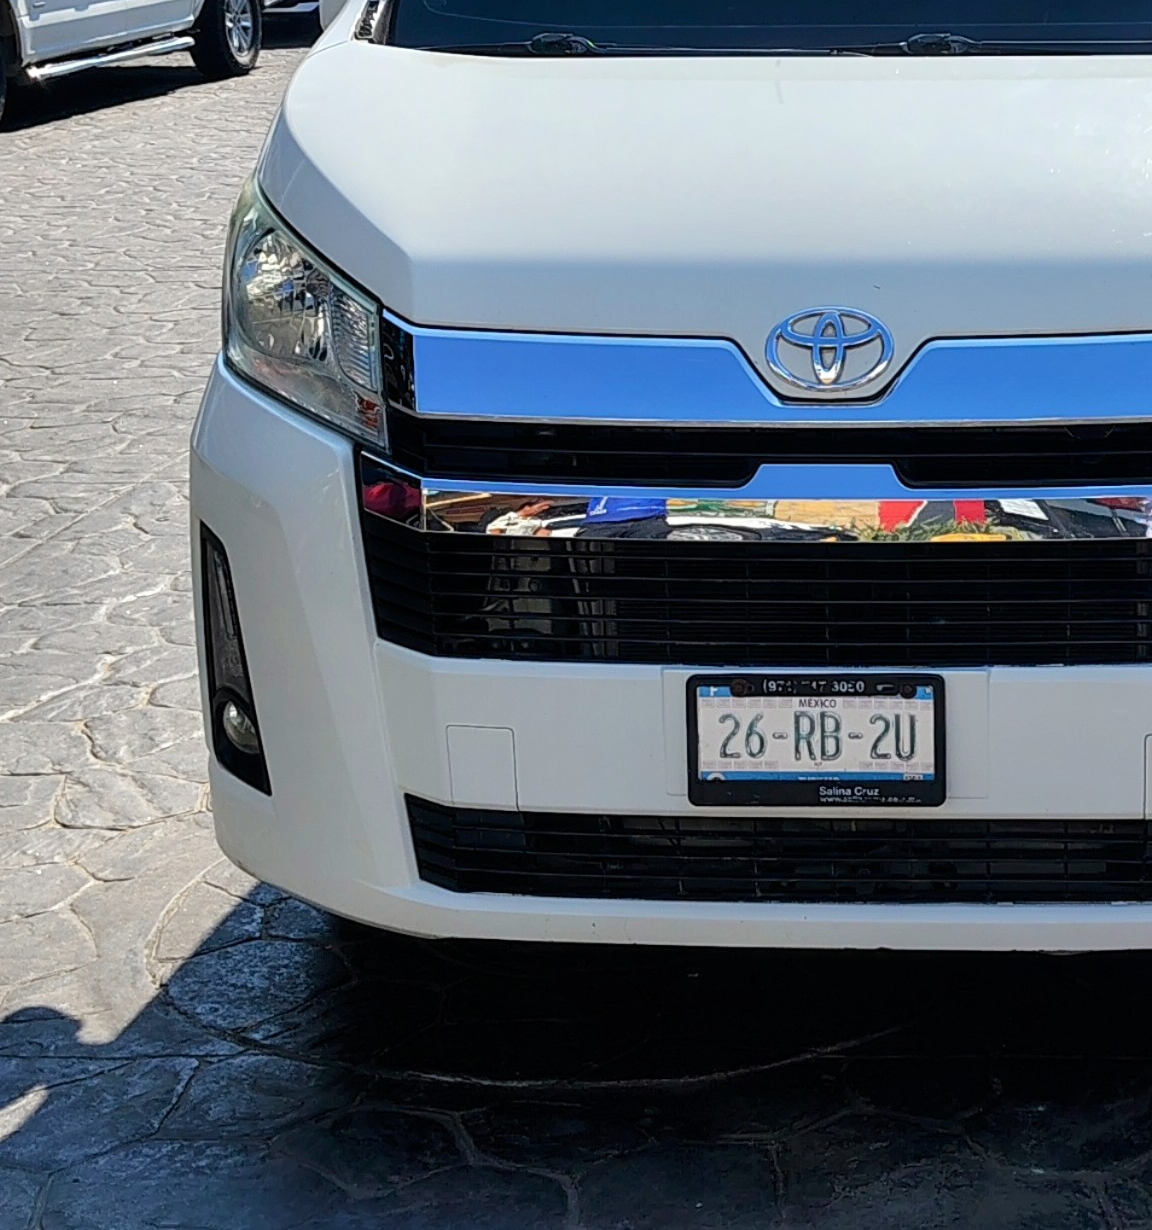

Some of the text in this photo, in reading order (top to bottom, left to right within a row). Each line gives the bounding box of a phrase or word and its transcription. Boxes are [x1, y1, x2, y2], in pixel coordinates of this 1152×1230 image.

[718, 711, 918, 761] 26-RB-2U
[819, 786, 880, 796] Salina Cruz
